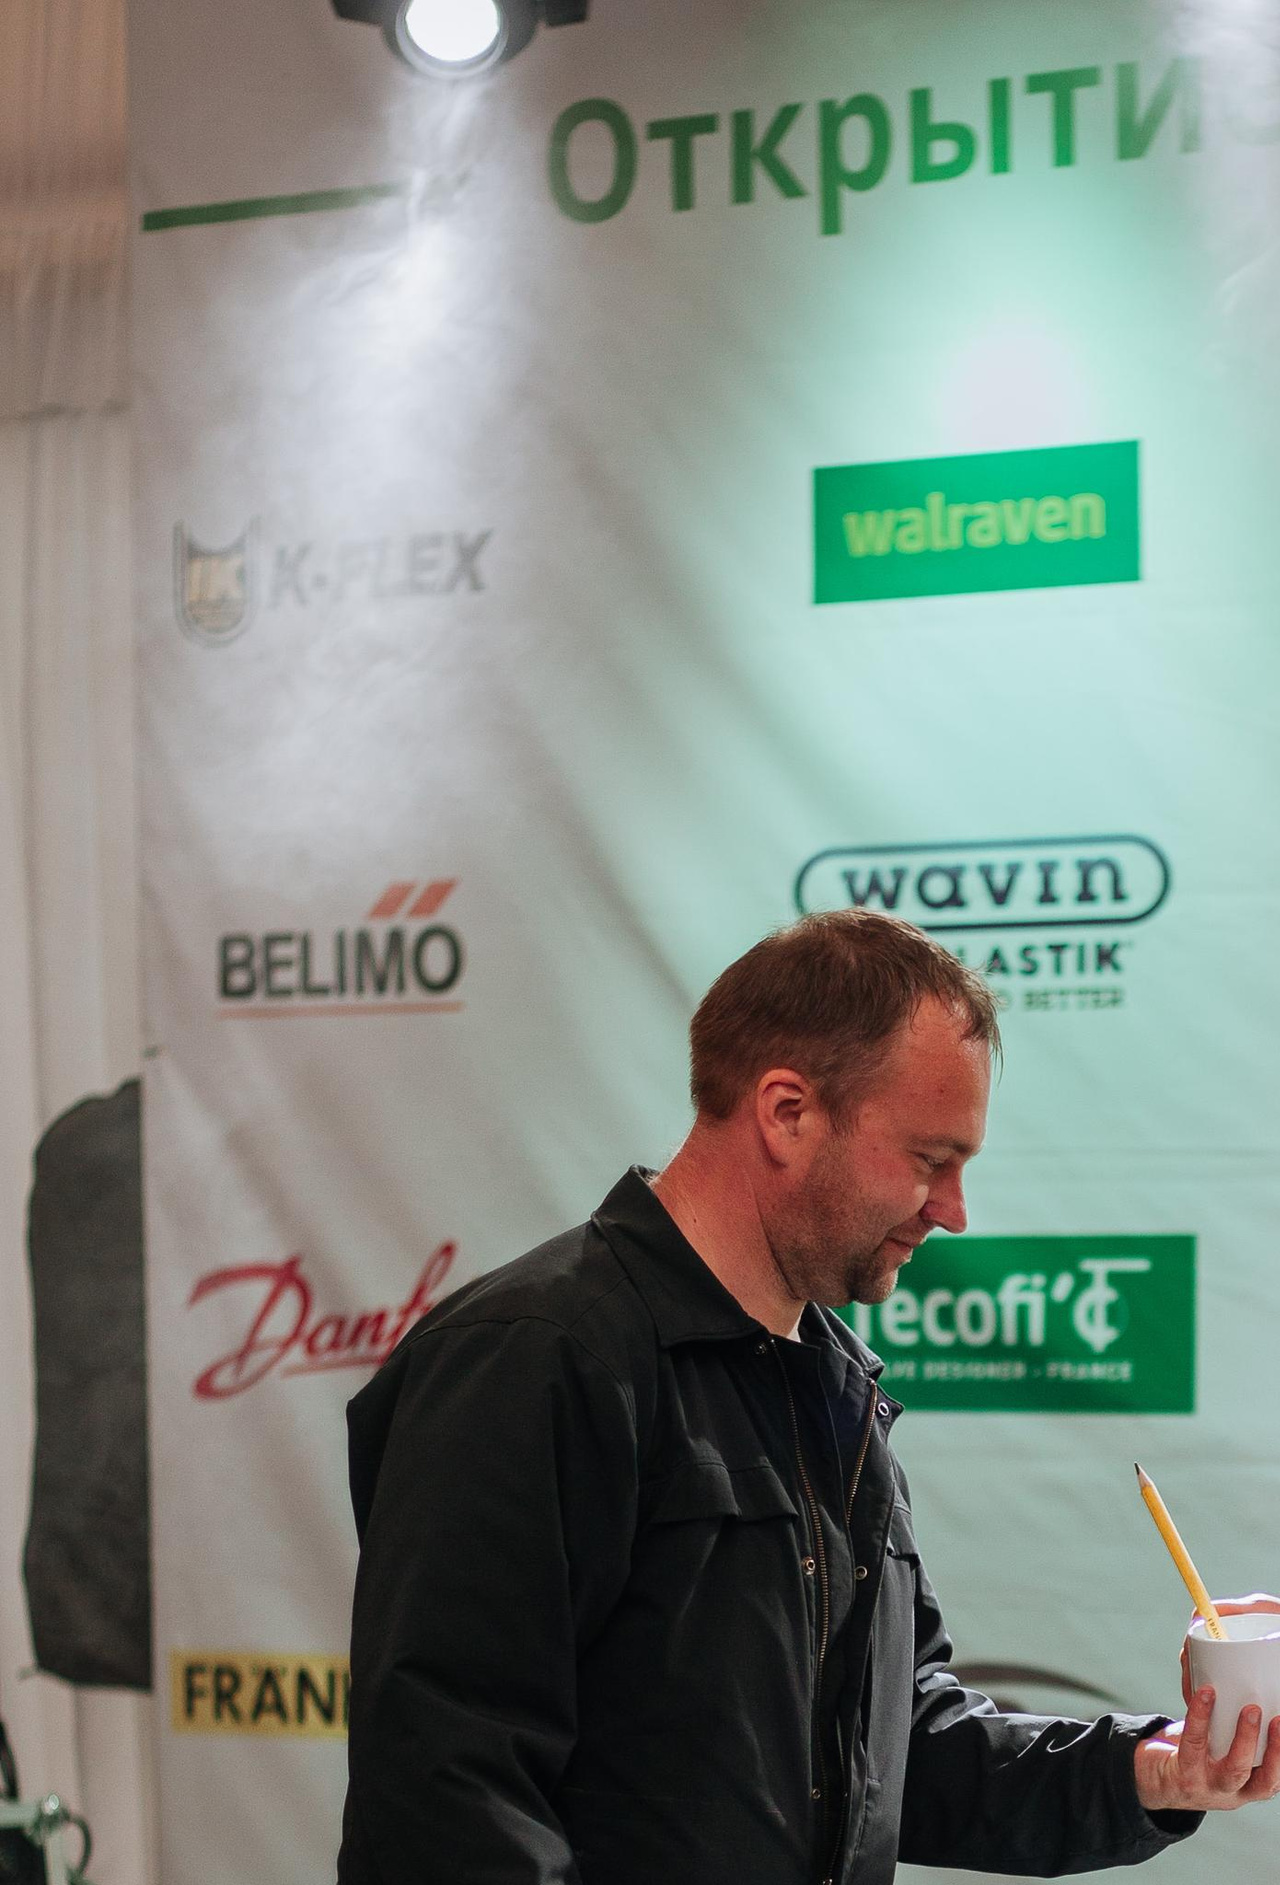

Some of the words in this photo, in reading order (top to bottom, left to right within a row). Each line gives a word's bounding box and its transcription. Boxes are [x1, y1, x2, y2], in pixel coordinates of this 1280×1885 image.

[842, 491, 1106, 558] walraven
[842, 858, 1128, 910] wavin
[217, 923, 465, 998] BELIMO
[187, 1240, 457, 1400] Danf
[185, 1662, 349, 1726] FRÄN
